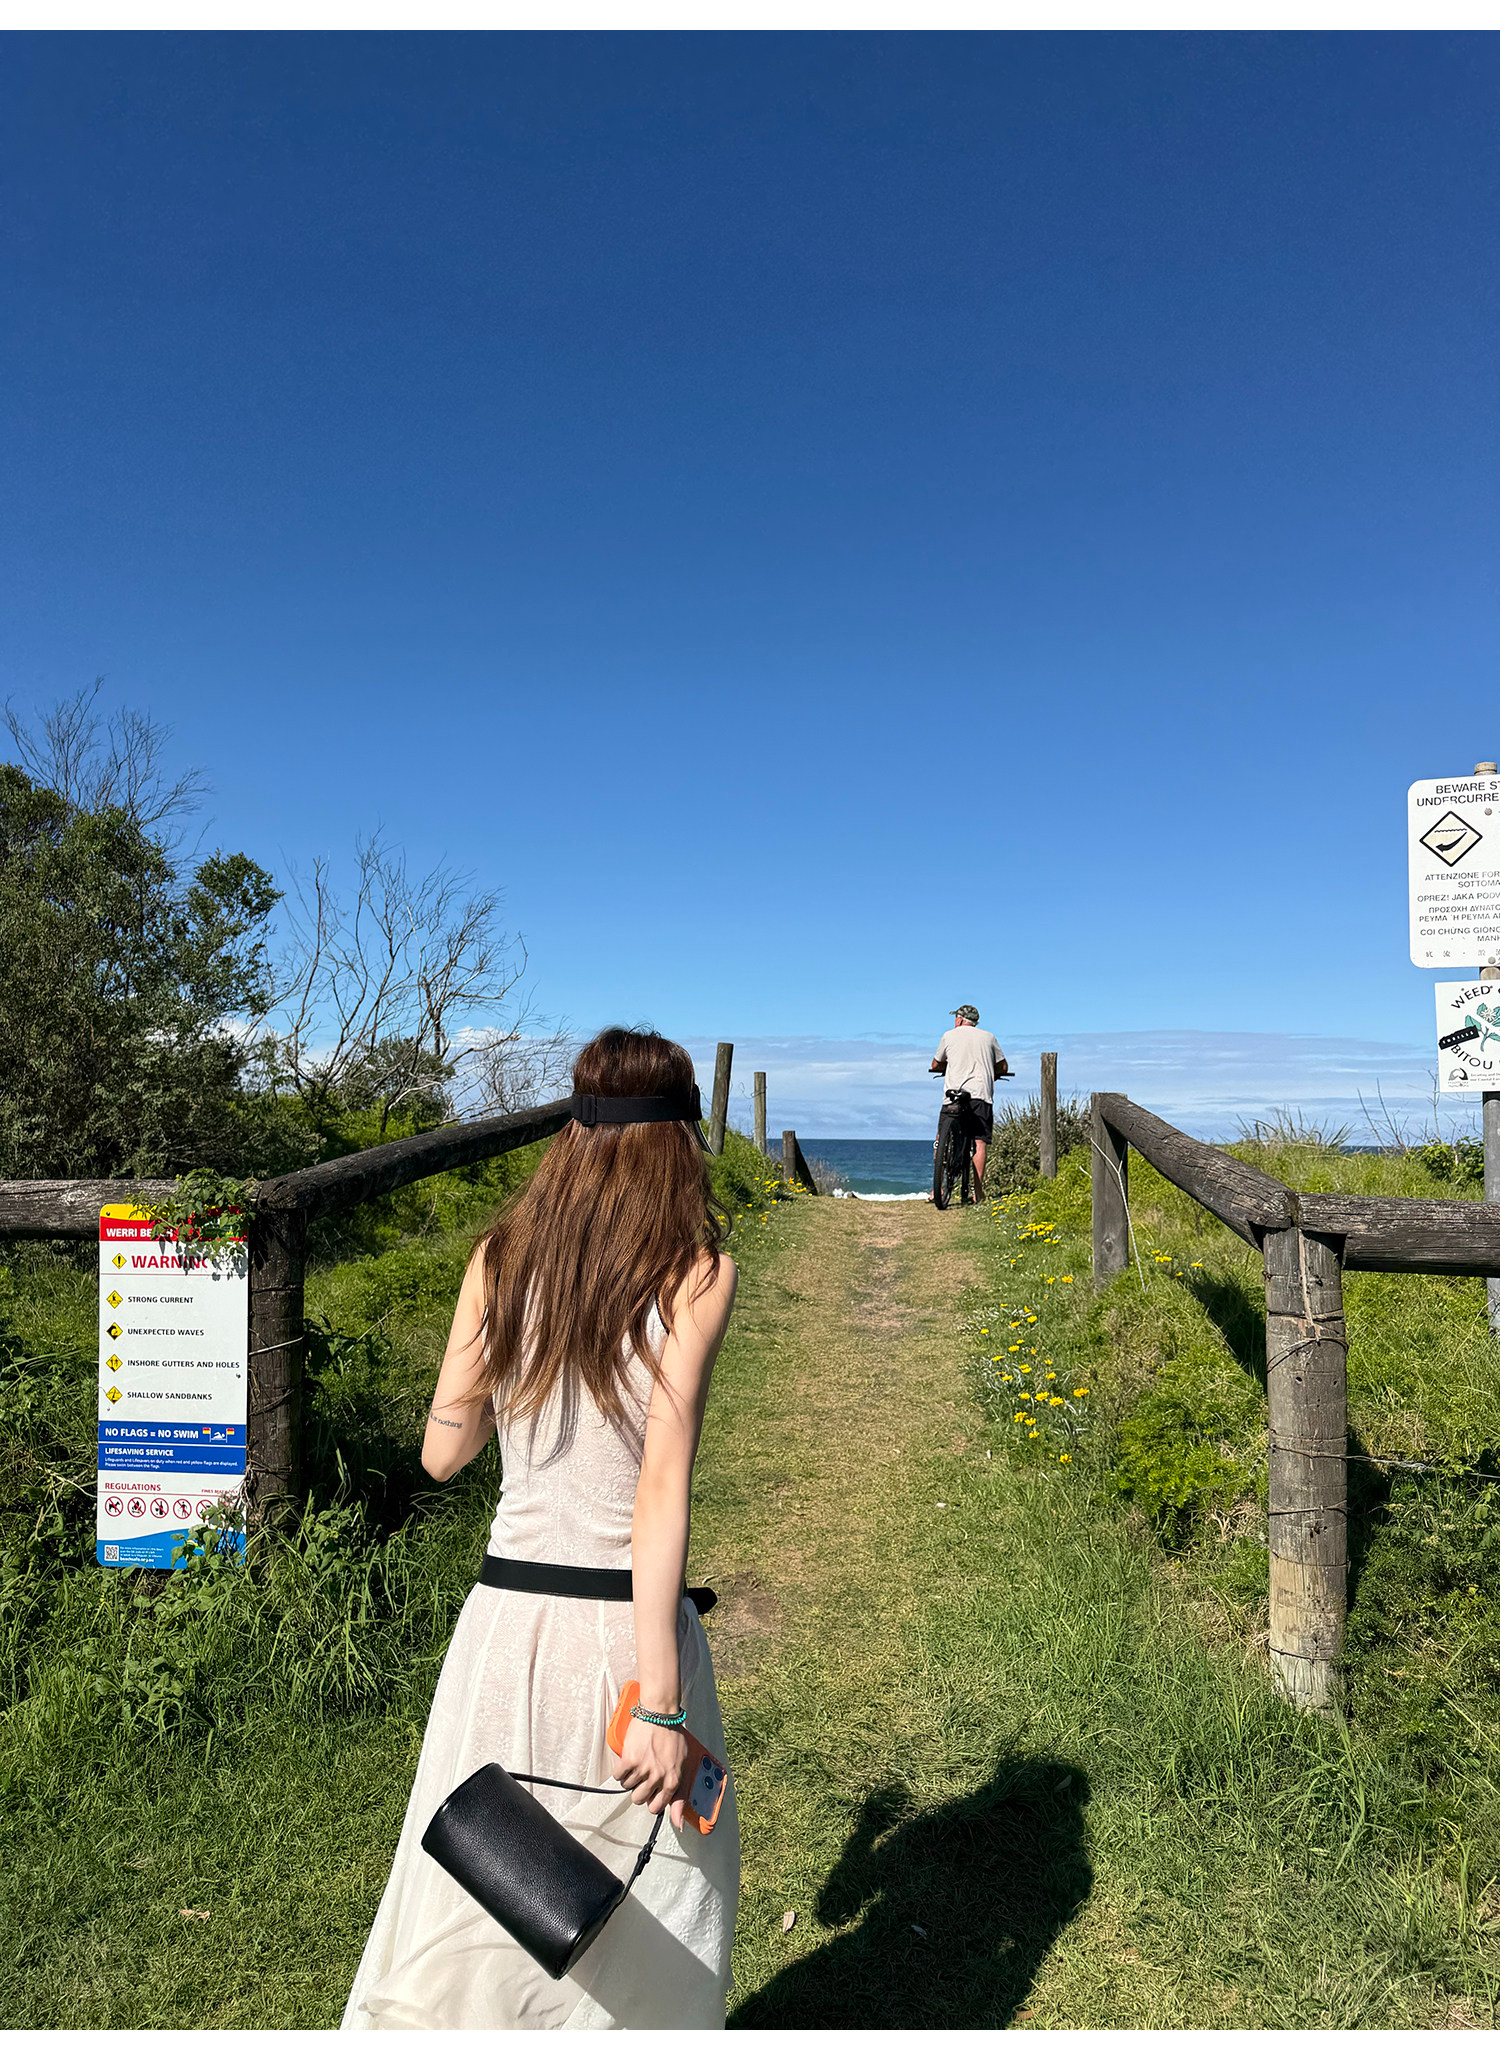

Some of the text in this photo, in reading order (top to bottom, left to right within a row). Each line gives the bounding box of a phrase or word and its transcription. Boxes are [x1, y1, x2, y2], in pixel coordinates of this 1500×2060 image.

[1436, 782, 1485, 794] BEWARE
[1425, 872, 1479, 881] ATTENZIONE
[1417, 894, 1449, 902] OPREZ!
[1452, 893, 1474, 901] JAKA
[1451, 985, 1491, 1009] WEED
[1451, 1044, 1493, 1070] BITOU
[106, 1227, 138, 1238] WERRI
[160, 1296, 194, 1304] CURRENT
[128, 1328, 176, 1336] UNEXPECTED
[105, 1428, 118, 1437] NO
[121, 1429, 149, 1438] FLAGS
[158, 1430, 171, 1438] NO
[174, 1431, 199, 1439] SWIM
[146, 1449, 174, 1457] SERVICE
[105, 1482, 161, 1491] REGULATIONS
